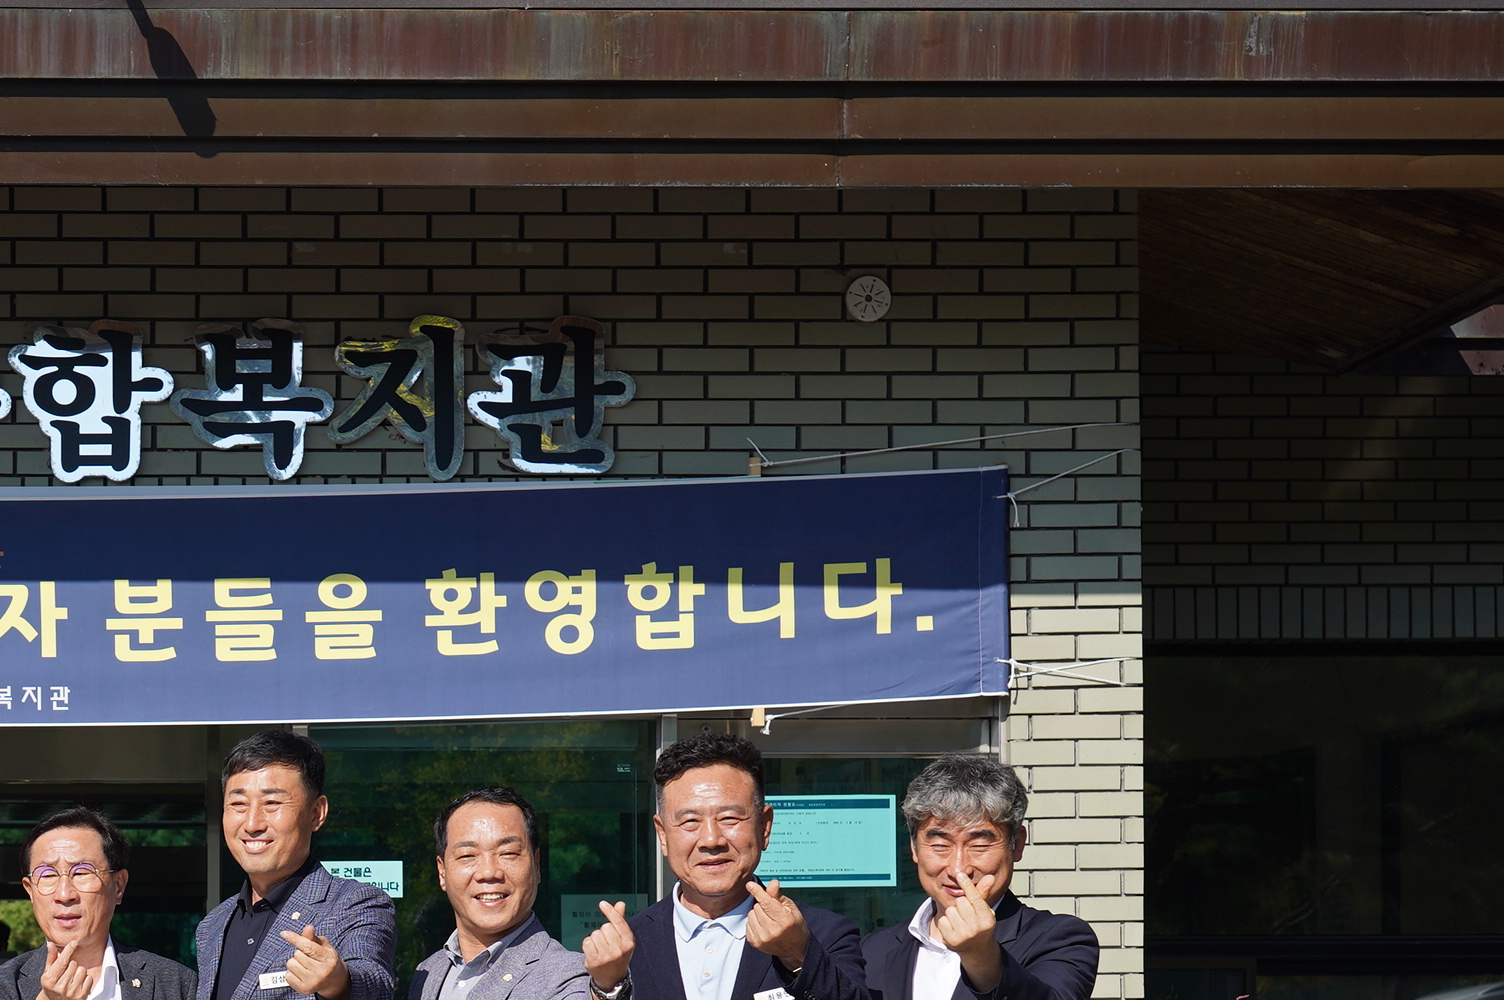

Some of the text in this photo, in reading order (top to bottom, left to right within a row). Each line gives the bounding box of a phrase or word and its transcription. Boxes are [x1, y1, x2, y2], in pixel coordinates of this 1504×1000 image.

[105, 575, 384, 664] 분들을
[424, 555, 934, 657] 환영합니다.
[342, 866, 373, 879] 건물은
